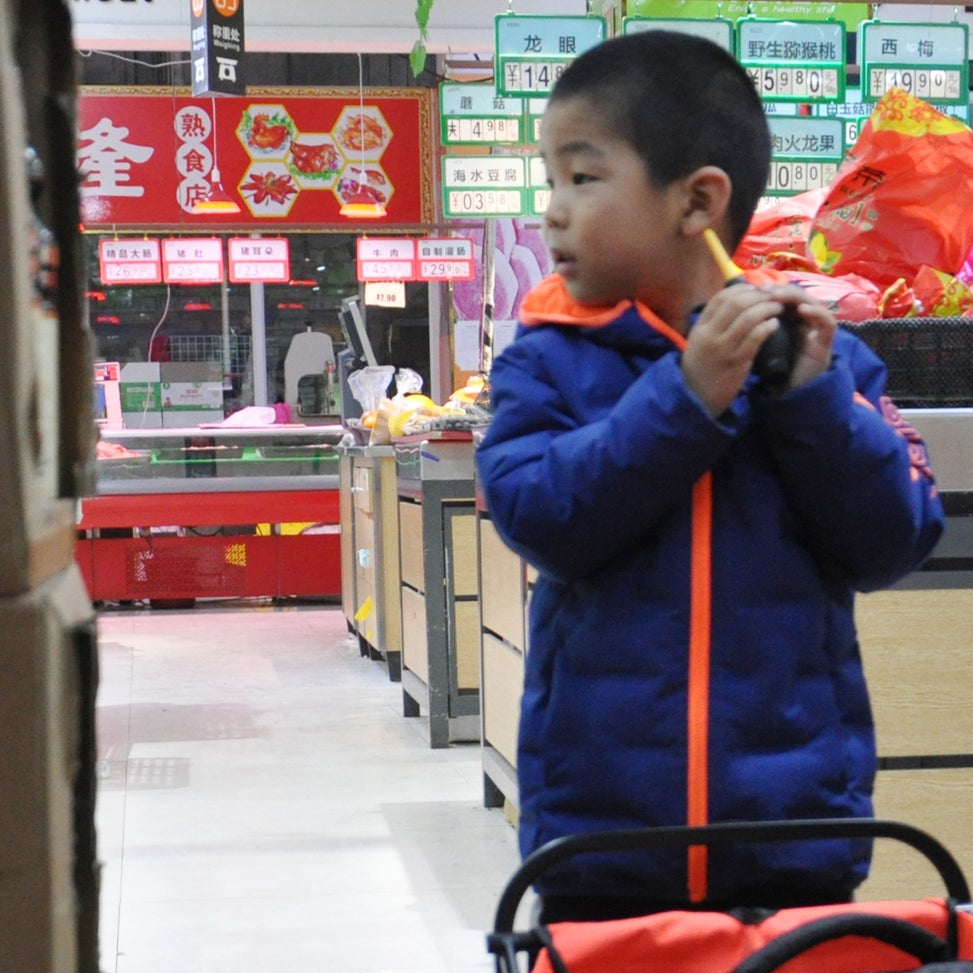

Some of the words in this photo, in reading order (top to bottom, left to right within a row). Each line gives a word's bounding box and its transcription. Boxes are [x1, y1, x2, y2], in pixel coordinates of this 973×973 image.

[773, 5, 811, 13] healthy
[524, 35, 577, 54] 龙眼
[748, 41, 836, 60] 野生猕猴桃
[881, 38, 934, 57] 西梅
[460, 96, 506, 110] 蘑菇
[180, 113, 206, 208] 熟食店
[453, 168, 518, 183] 海水豆腐
[106, 248, 152, 259] 精品大肠
[240, 246, 274, 257] 猪耳朵
[372, 247, 399, 258] 牛肉
